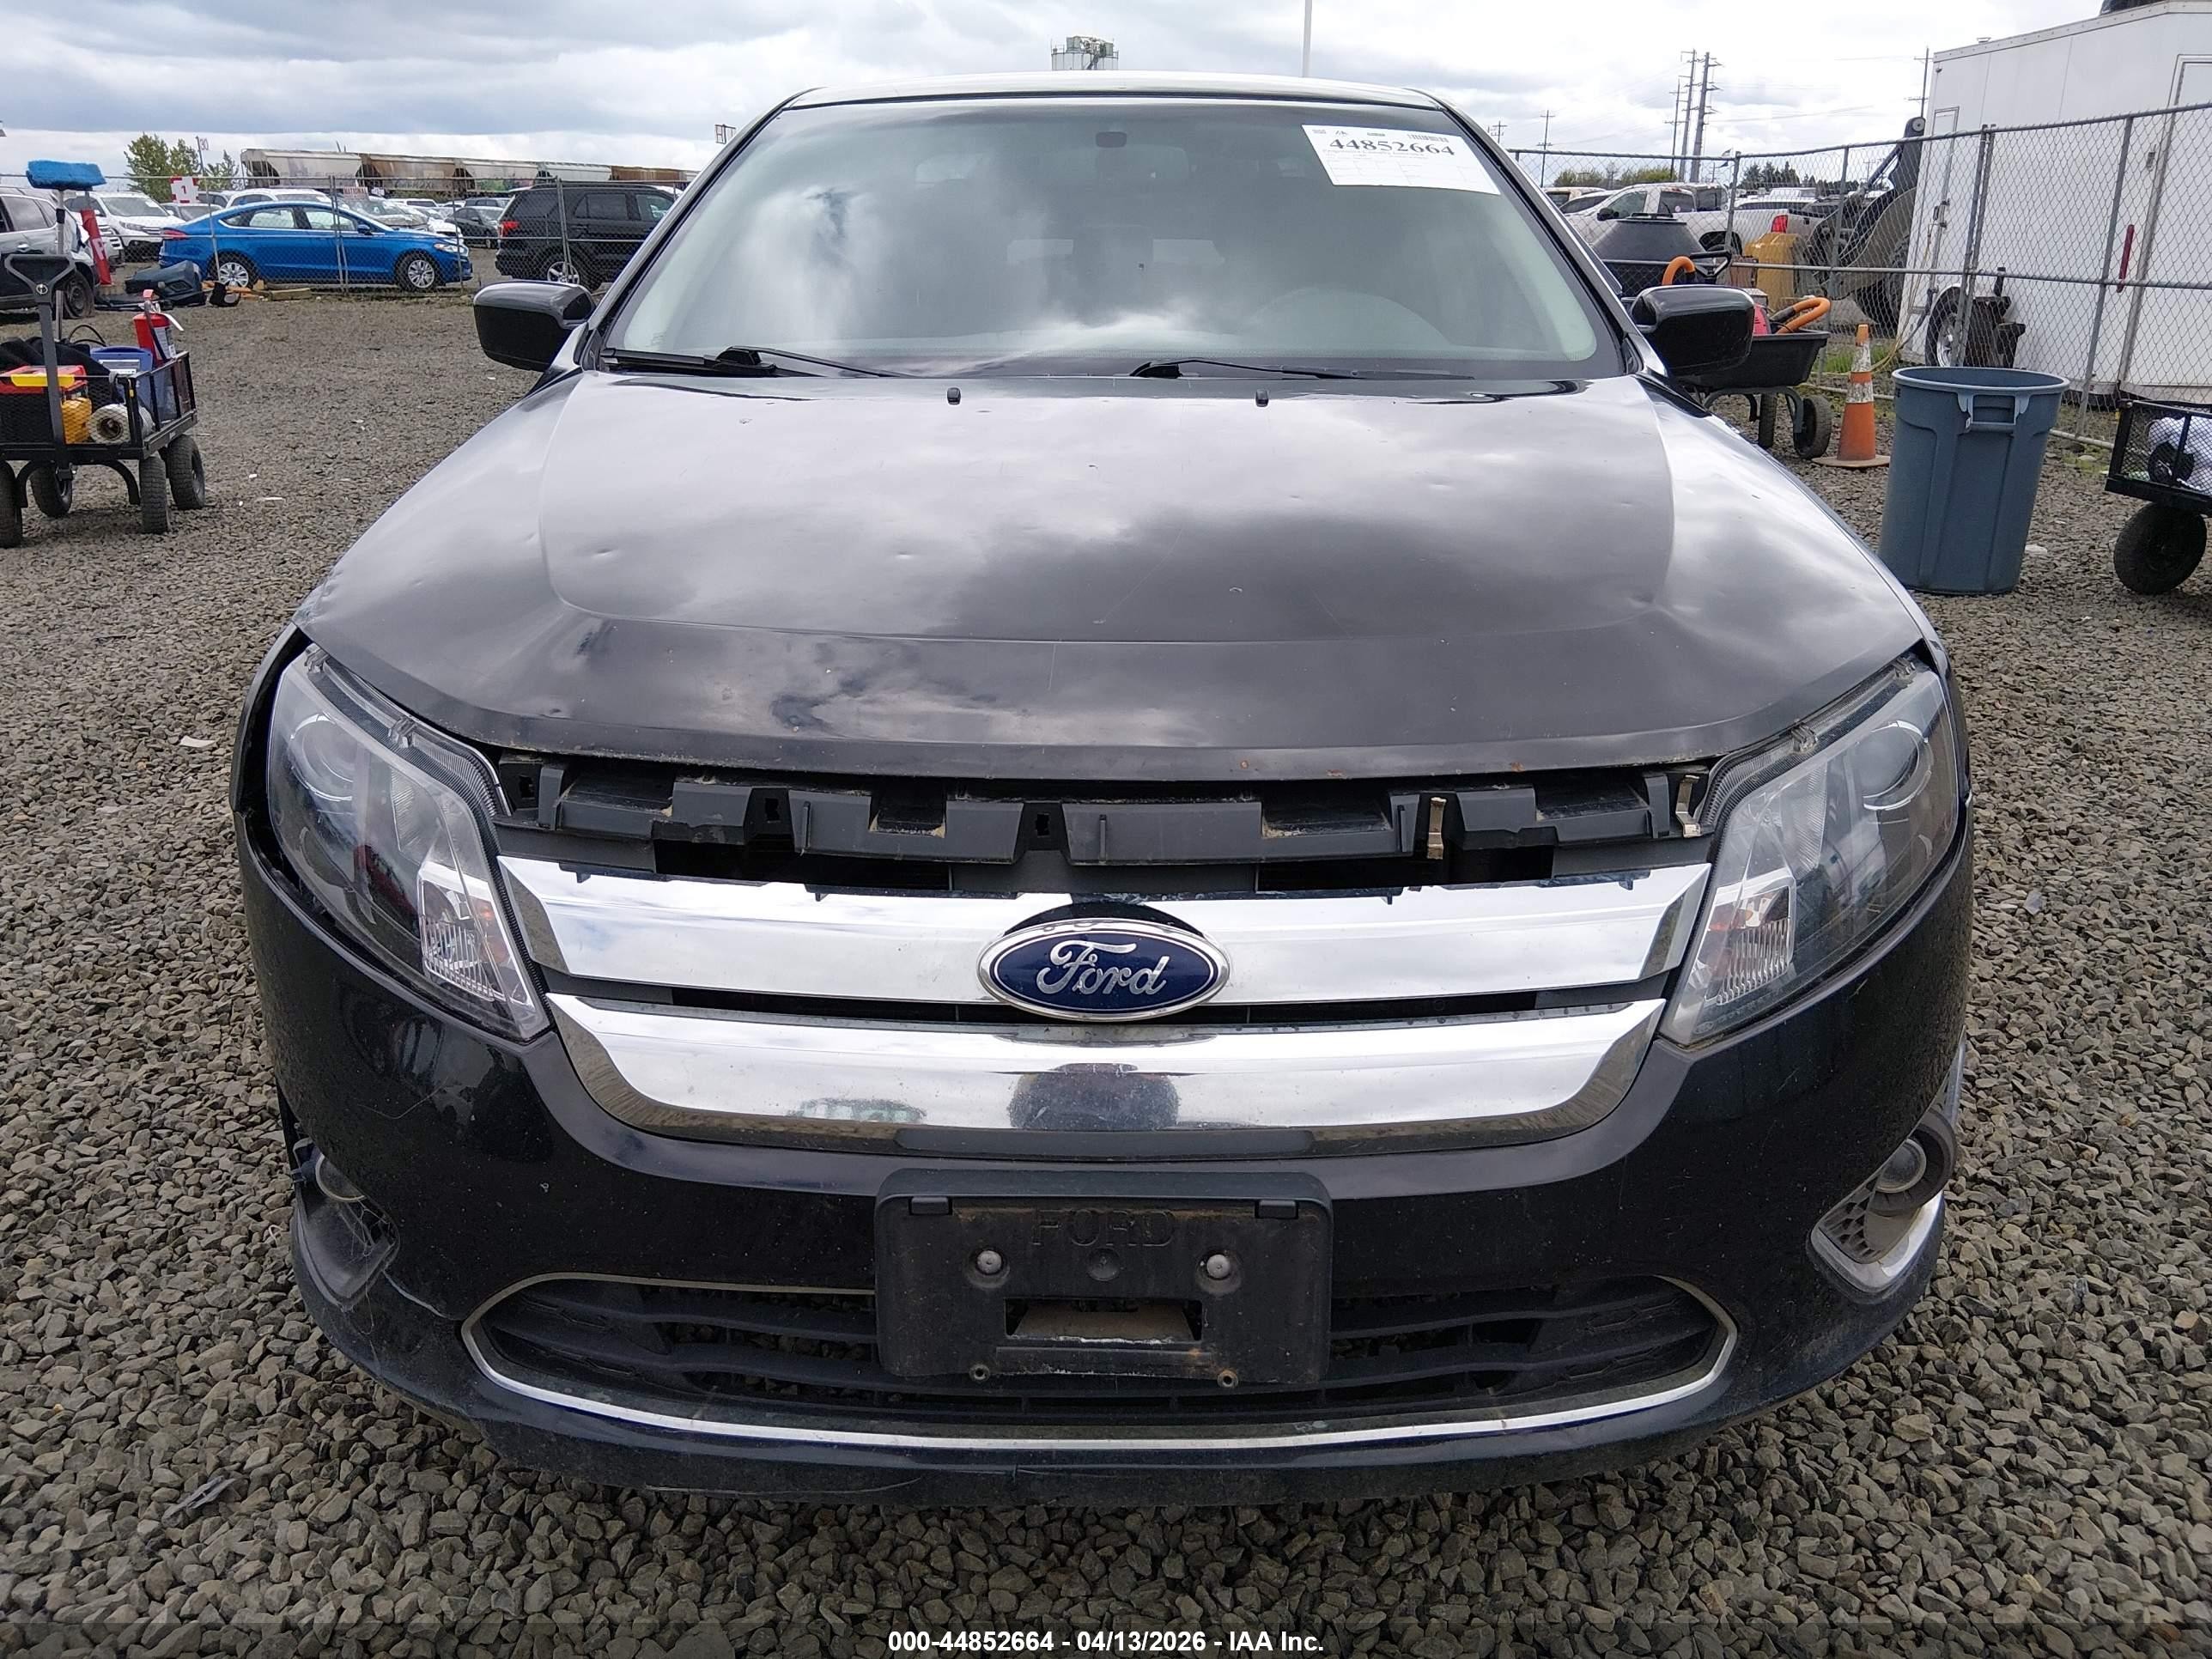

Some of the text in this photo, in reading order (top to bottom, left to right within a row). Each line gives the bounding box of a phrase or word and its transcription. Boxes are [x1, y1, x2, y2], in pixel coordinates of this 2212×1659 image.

[1329, 138, 1455, 156] 44852664
[1036, 939, 1170, 995] Ford
[1030, 1207, 1175, 1247] FORD
